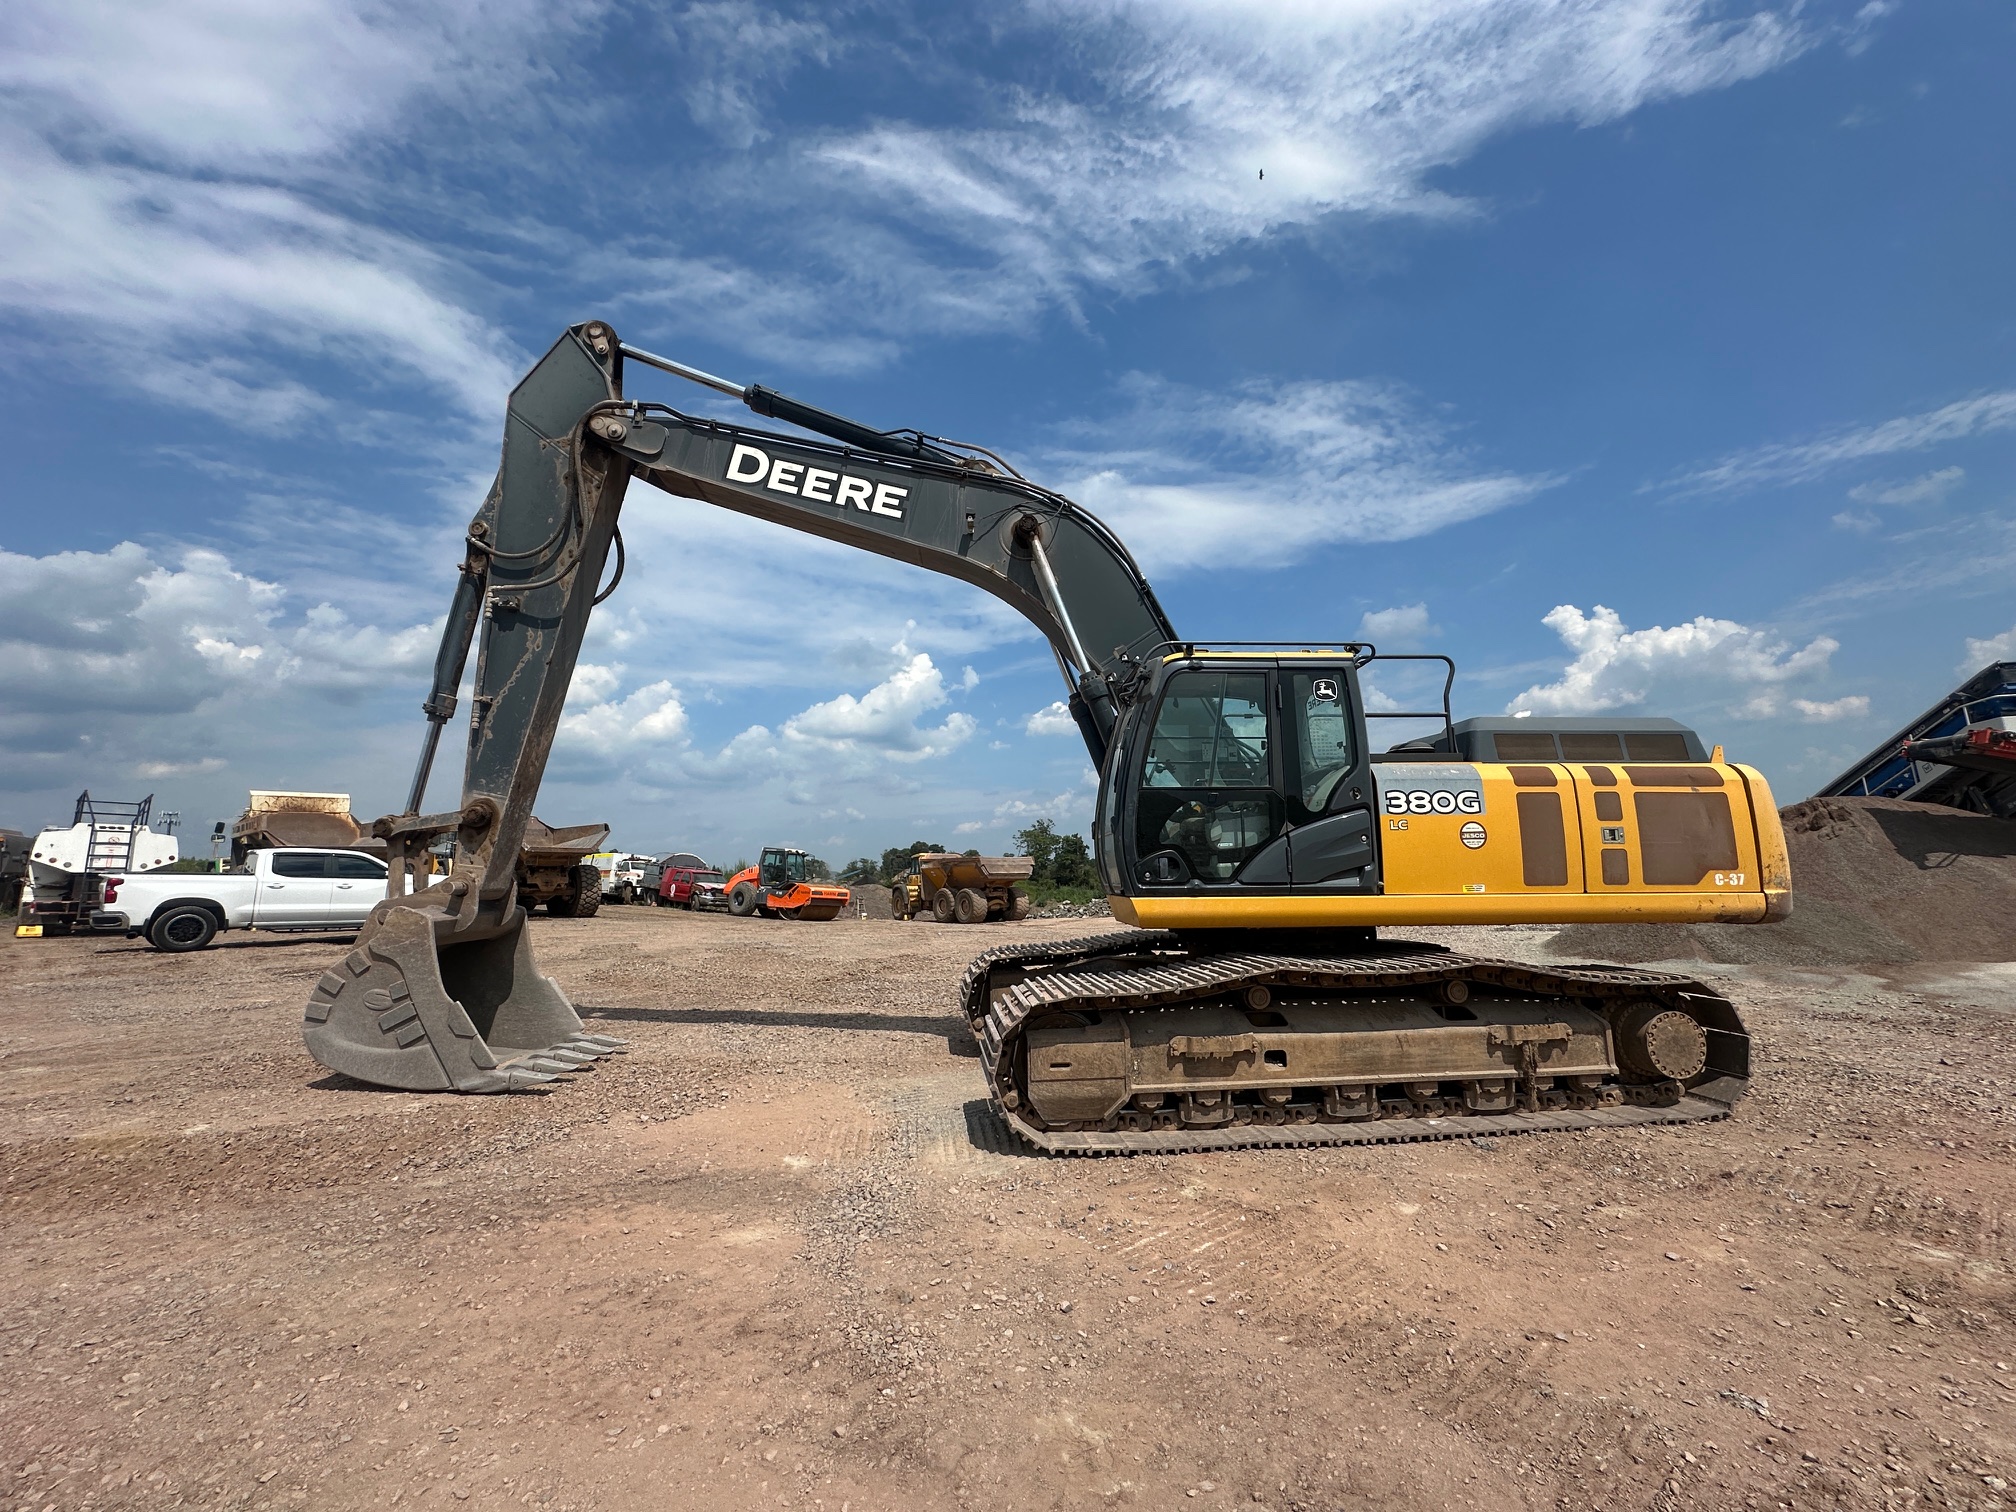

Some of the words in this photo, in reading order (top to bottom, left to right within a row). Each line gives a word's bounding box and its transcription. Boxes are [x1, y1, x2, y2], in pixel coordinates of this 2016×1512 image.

[725, 443, 908, 519] DEERE
[1385, 790, 1481, 814] 380G
[1389, 820, 1408, 830] LC
[1714, 873, 1745, 886] C-37
